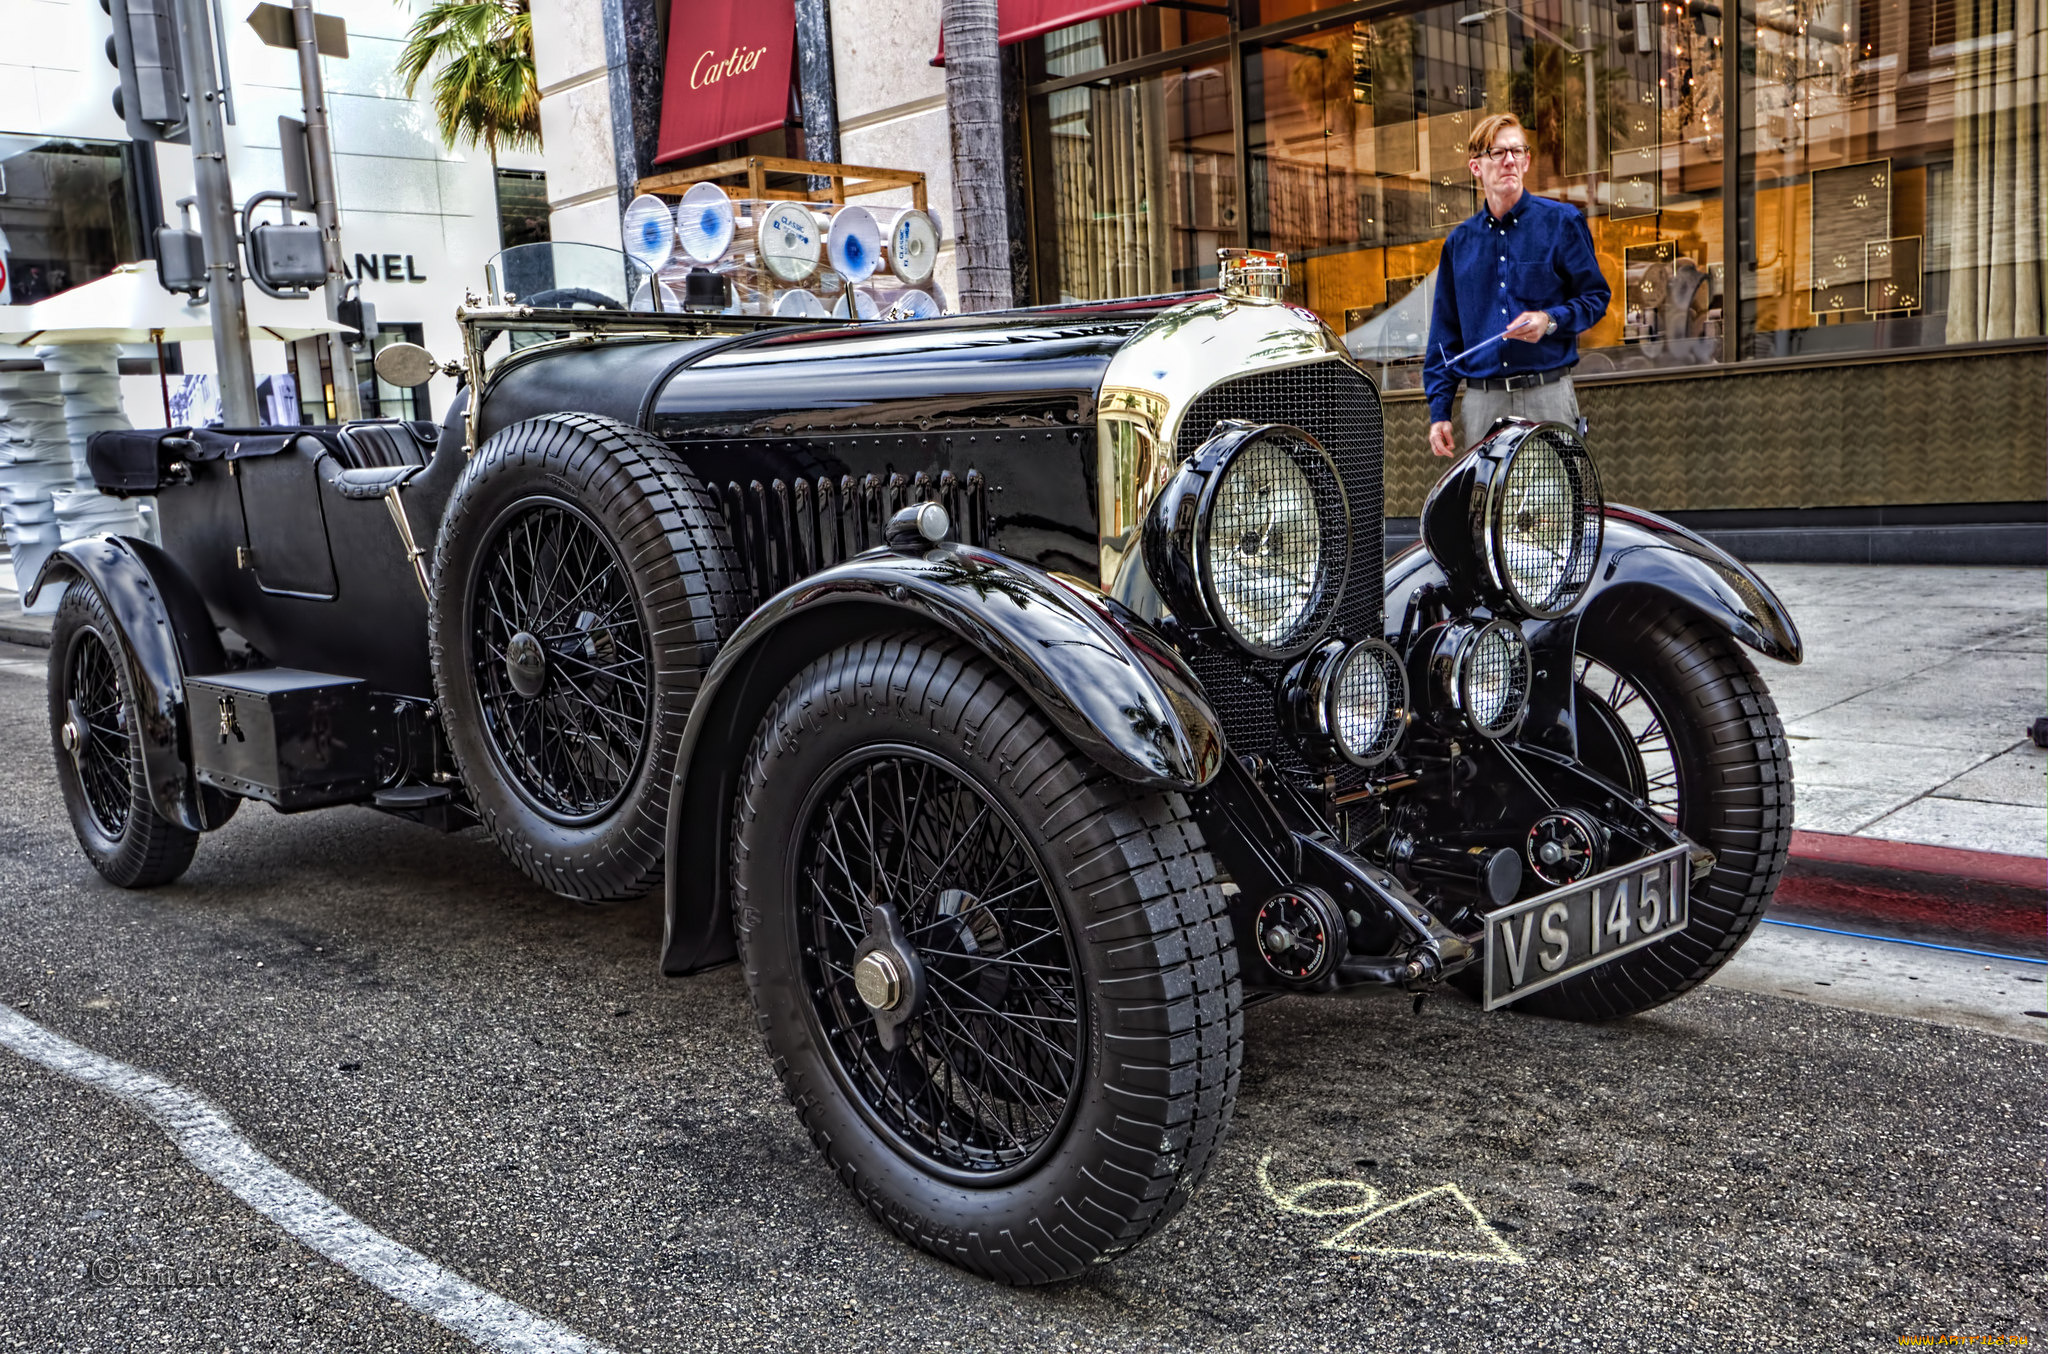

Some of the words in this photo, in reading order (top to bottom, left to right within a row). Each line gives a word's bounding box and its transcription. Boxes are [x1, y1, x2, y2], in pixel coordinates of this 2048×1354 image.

[690, 46, 767, 90] Cartier
[1500, 902, 1569, 985] VS
[1591, 860, 1678, 955] 1451
